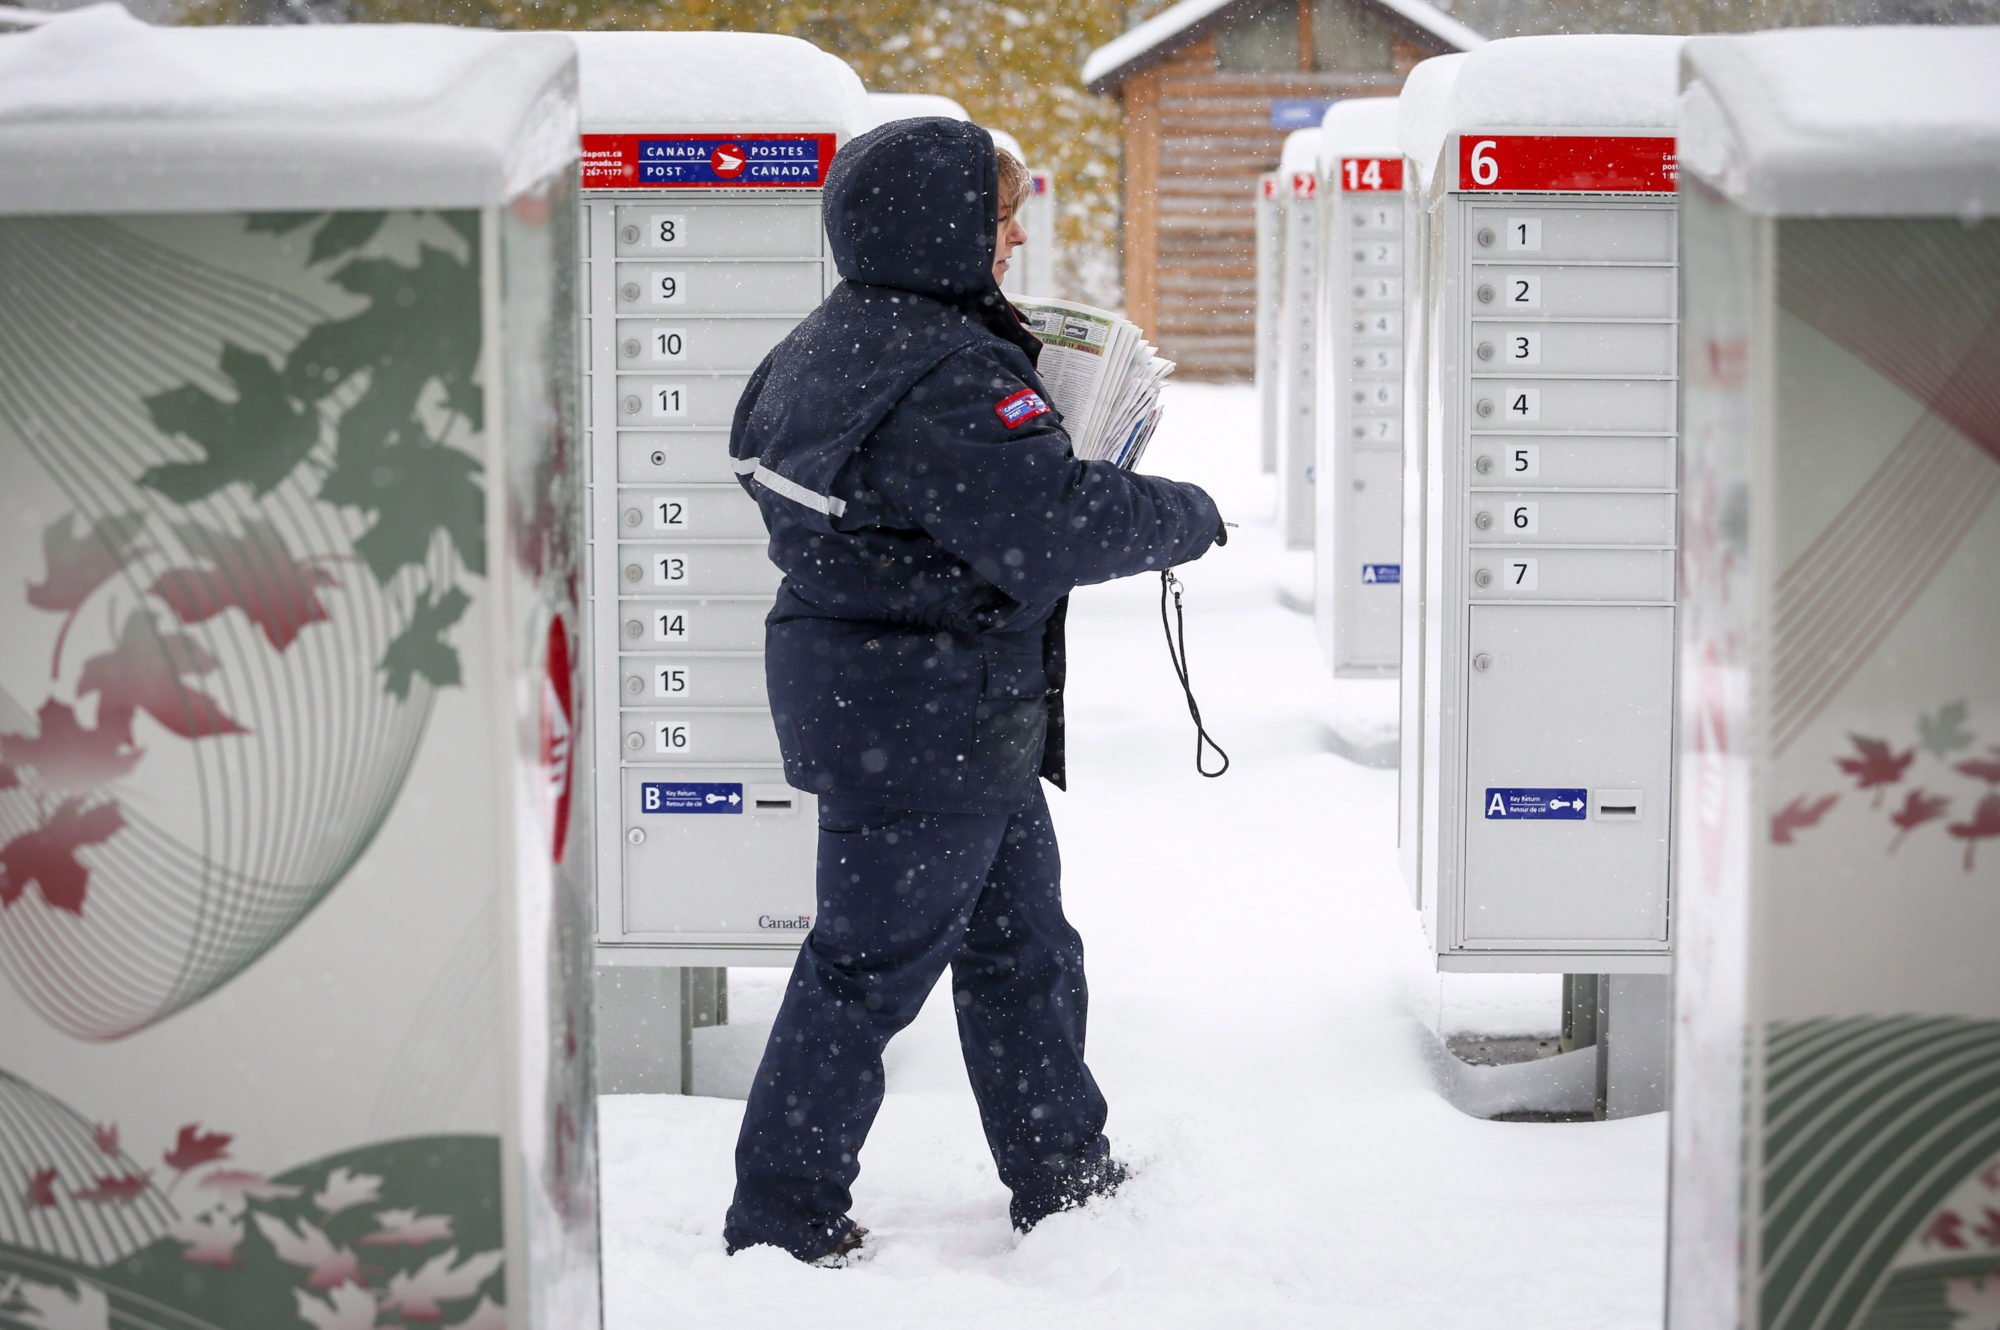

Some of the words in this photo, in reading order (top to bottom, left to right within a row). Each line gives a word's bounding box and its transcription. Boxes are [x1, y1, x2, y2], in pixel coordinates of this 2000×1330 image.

[579, 150, 622, 158] dapost.ca
[647, 147, 706, 157] CANADA
[751, 147, 803, 156] POSTES
[586, 167, 622, 176] 267-1177
[647, 167, 682, 176] POST
[751, 167, 811, 176] CANADA
[1471, 141, 1498, 185] 6
[1345, 160, 1382, 189] 14
[1662, 172, 1667, 180] 1
[1379, 212, 1386, 224] 1
[661, 221, 674, 241] 8
[1518, 224, 1525, 244] 1
[1378, 248, 1387, 261] 2
[662, 278, 675, 298] 9
[1378, 283, 1387, 297] 3
[1516, 281, 1528, 301] 2
[1377, 318, 1387, 331] 4
[658, 334, 681, 354] 10
[1516, 337, 1528, 358] 3
[1378, 353, 1387, 367] 5
[659, 391, 678, 410] 11
[1378, 388, 1387, 401] 6
[1004, 400, 1024, 413] CANADA
[1009, 409, 1022, 419] POST
[1513, 395, 1528, 414] 4
[1379, 423, 1387, 437] 7
[1516, 451, 1528, 471] 5
[660, 503, 682, 523] 12
[1514, 507, 1528, 528] 6
[661, 559, 683, 579] 13
[1363, 565, 1377, 583] A
[1514, 564, 1527, 584] 7
[660, 616, 684, 635] 14
[661, 671, 684, 691] 15
[662, 727, 686, 747] 16
[646, 787, 660, 809] B
[1487, 793, 1507, 815] A
[758, 915, 810, 929] Canada
